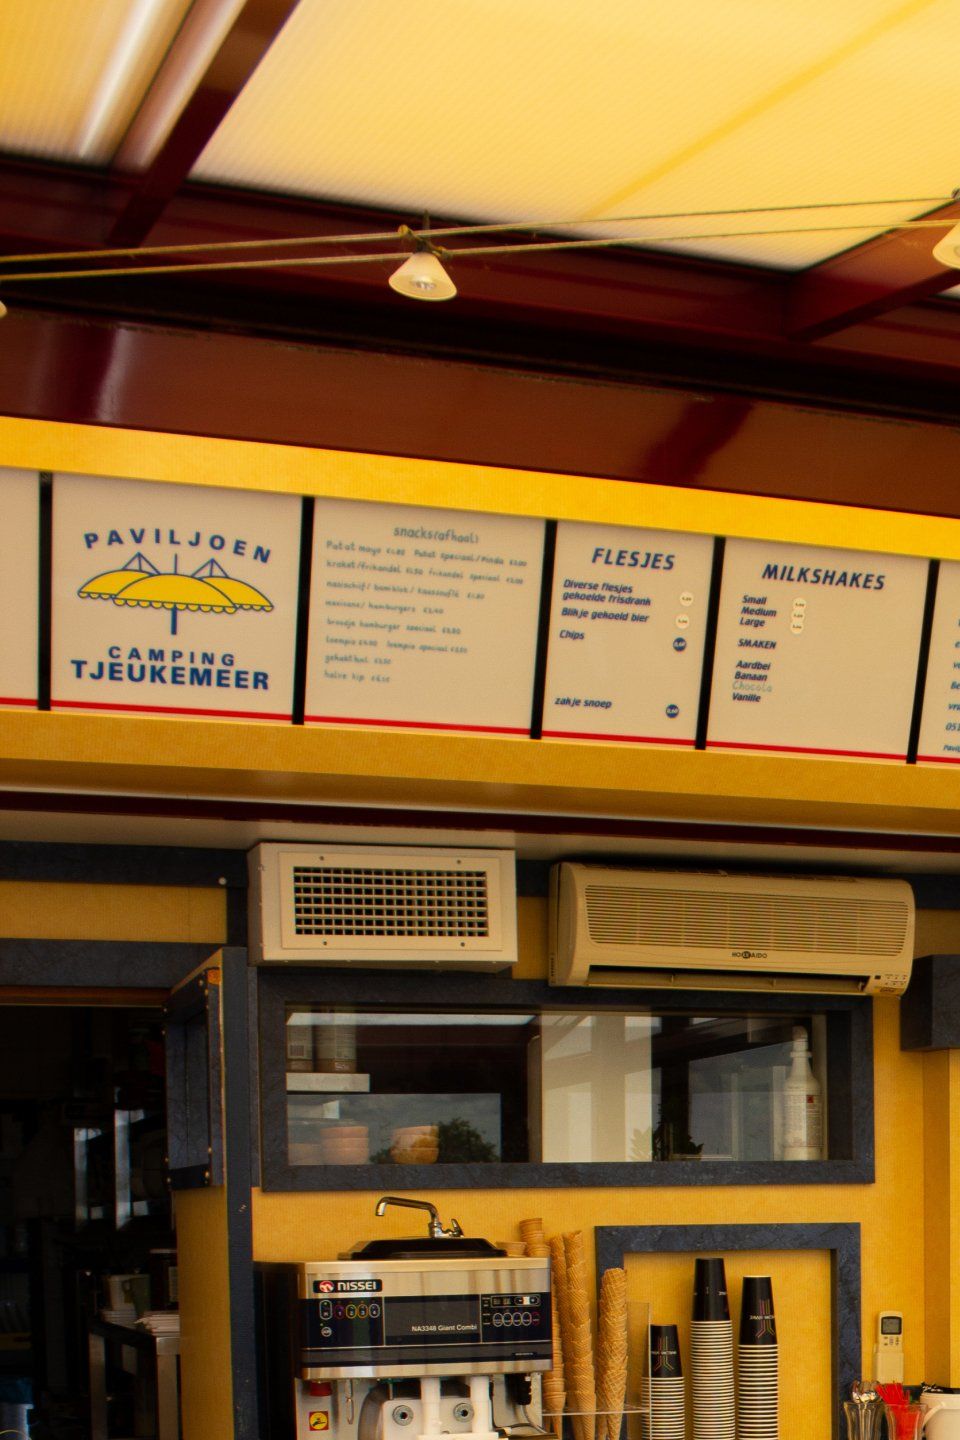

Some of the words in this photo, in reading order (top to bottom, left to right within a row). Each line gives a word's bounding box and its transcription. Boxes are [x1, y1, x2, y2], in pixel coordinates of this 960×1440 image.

[84, 528, 271, 563] PAVILJOEN
[592, 547, 675, 571] FLESJES
[762, 563, 886, 590] MILKSHAKES
[564, 578, 599, 591] Diverse
[601, 581, 633, 594] flesjes
[563, 590, 606, 602] gekoelde
[608, 594, 652, 606] frisdrank
[742, 594, 767, 605] Small
[561, 607, 589, 619] Blikje
[591, 610, 628, 621] gekoeld
[631, 613, 649, 622] bier
[741, 606, 777, 617] Medium
[739, 617, 765, 628] Large
[559, 629, 585, 641] Chips
[738, 638, 776, 649] SMAKEN
[108, 646, 235, 666] CAMPING
[735, 660, 771, 671] Aardbei
[70, 659, 269, 690] TJEUKEMEER
[734, 671, 768, 682] Banaan
[555, 697, 581, 708] zakje
[583, 699, 612, 710] snoep
[732, 692, 761, 703] Vanille
[337, 1281, 377, 1291] NISSEI
[438, 1324, 455, 1332] Giant
[456, 1323, 477, 1331] Combi
